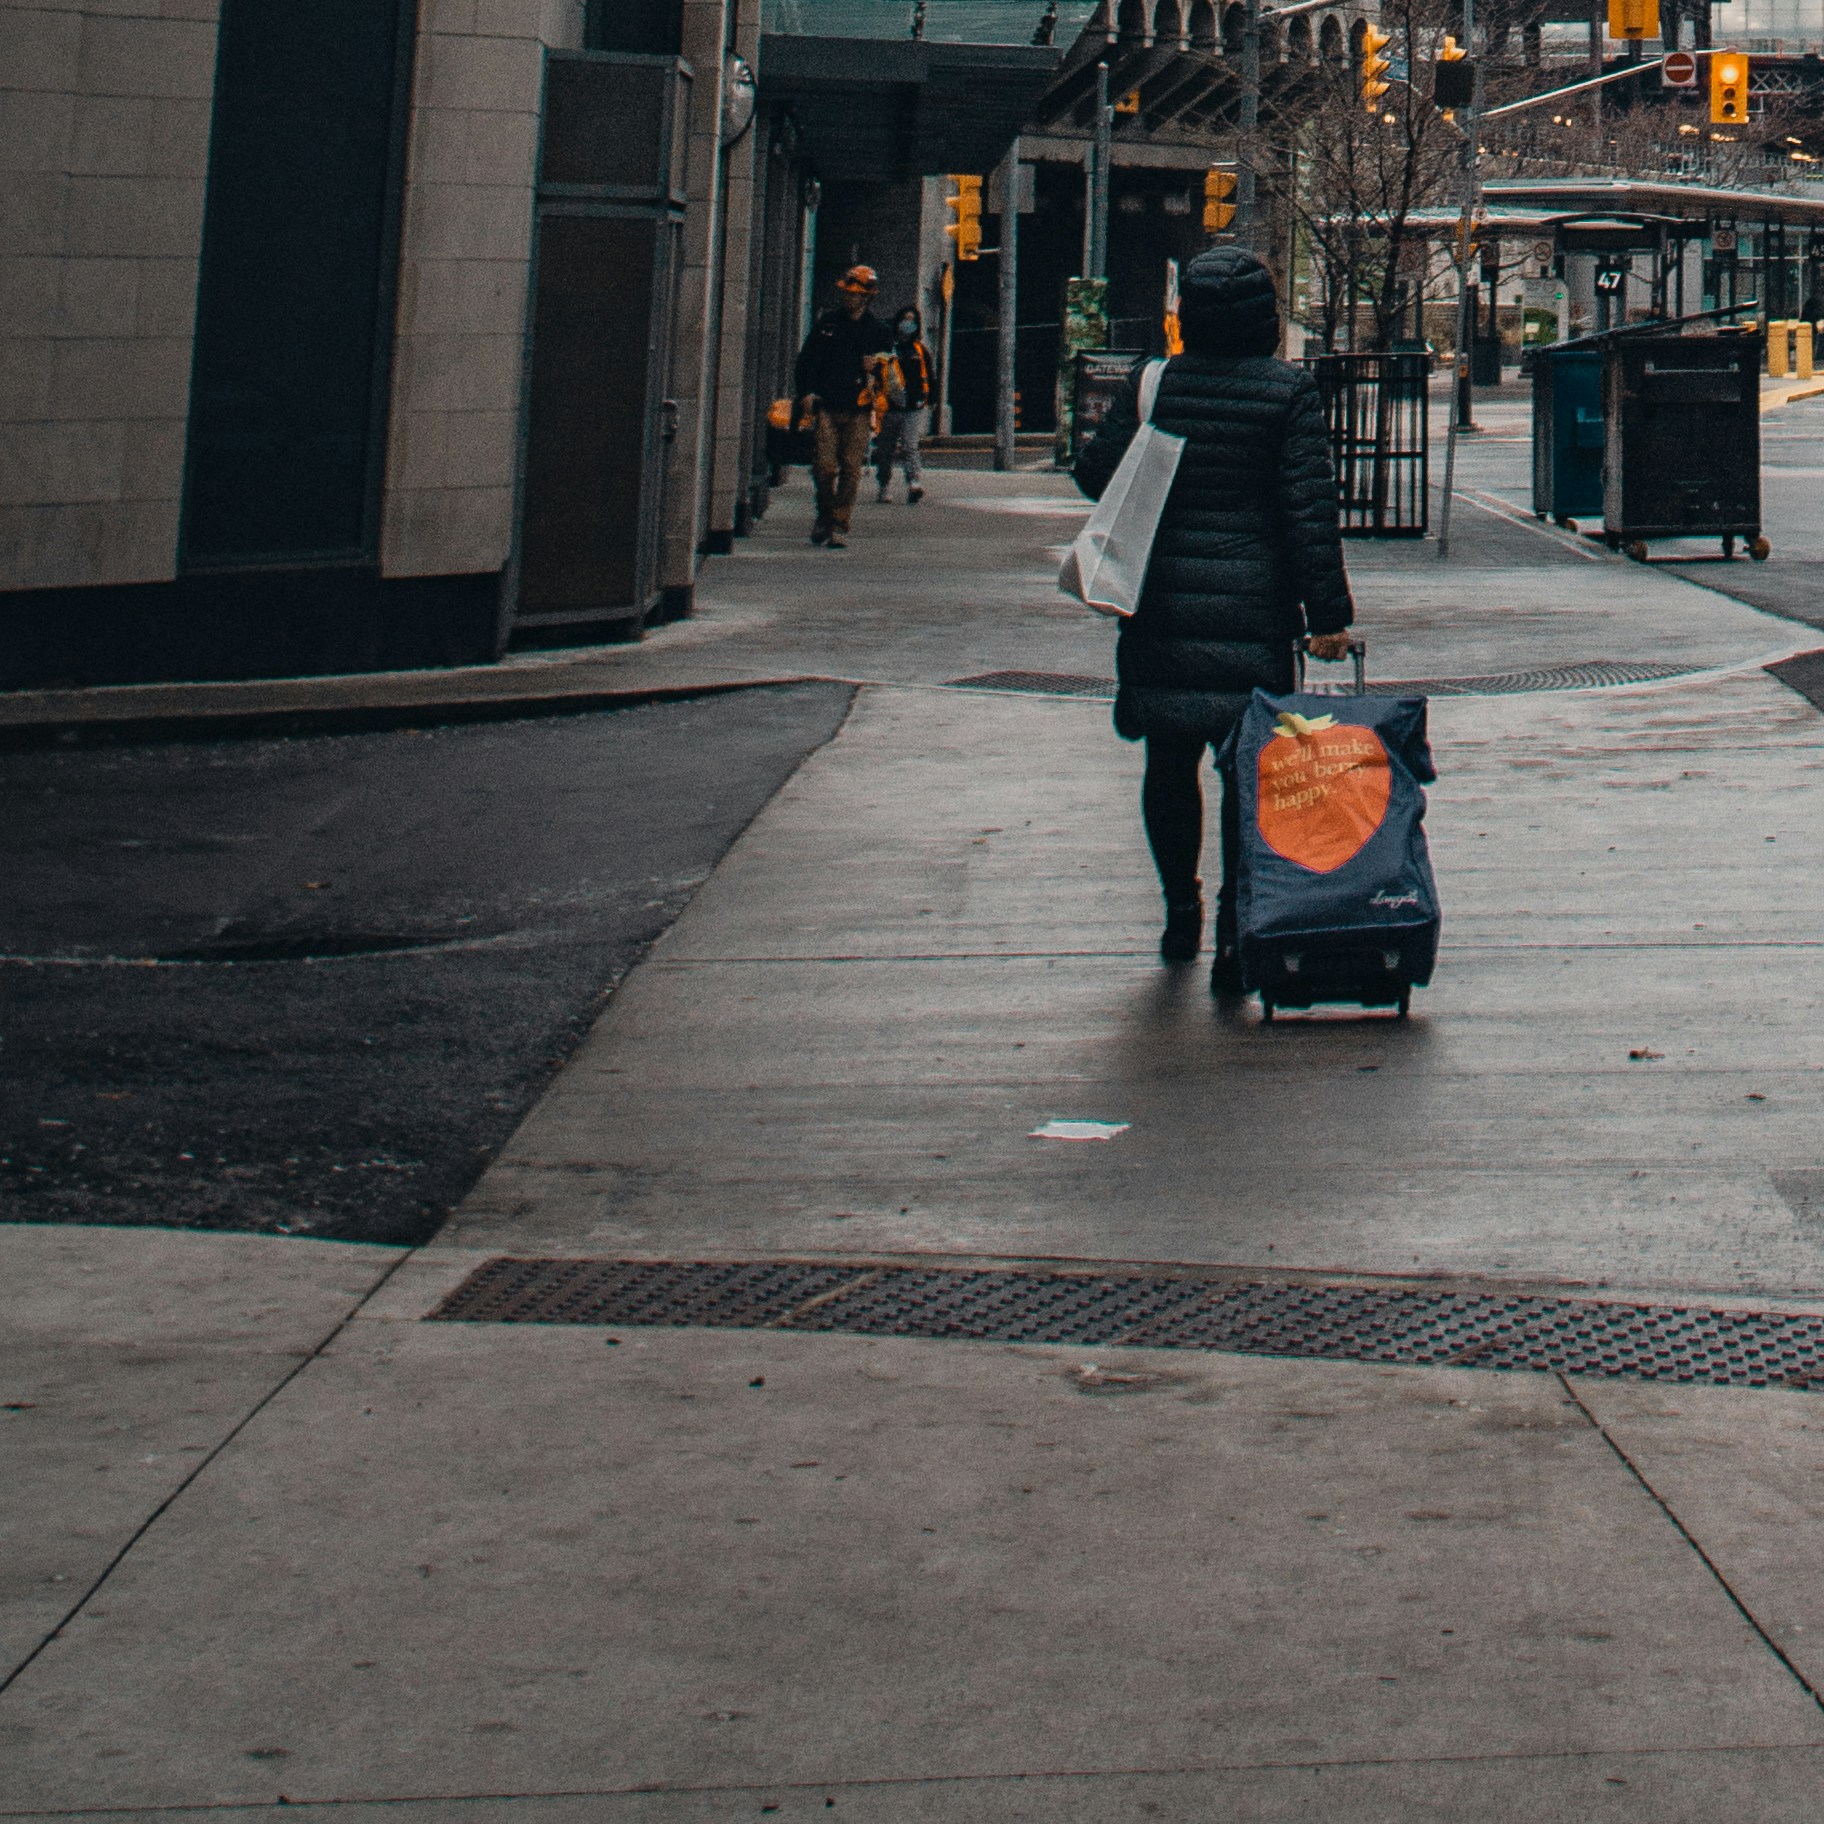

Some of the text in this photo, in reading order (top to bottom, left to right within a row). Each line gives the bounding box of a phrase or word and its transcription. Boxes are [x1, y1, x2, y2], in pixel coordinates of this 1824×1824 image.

[1597, 271, 1622, 290] 47
[1320, 738, 1374, 756] make
[1273, 770, 1307, 791] you
